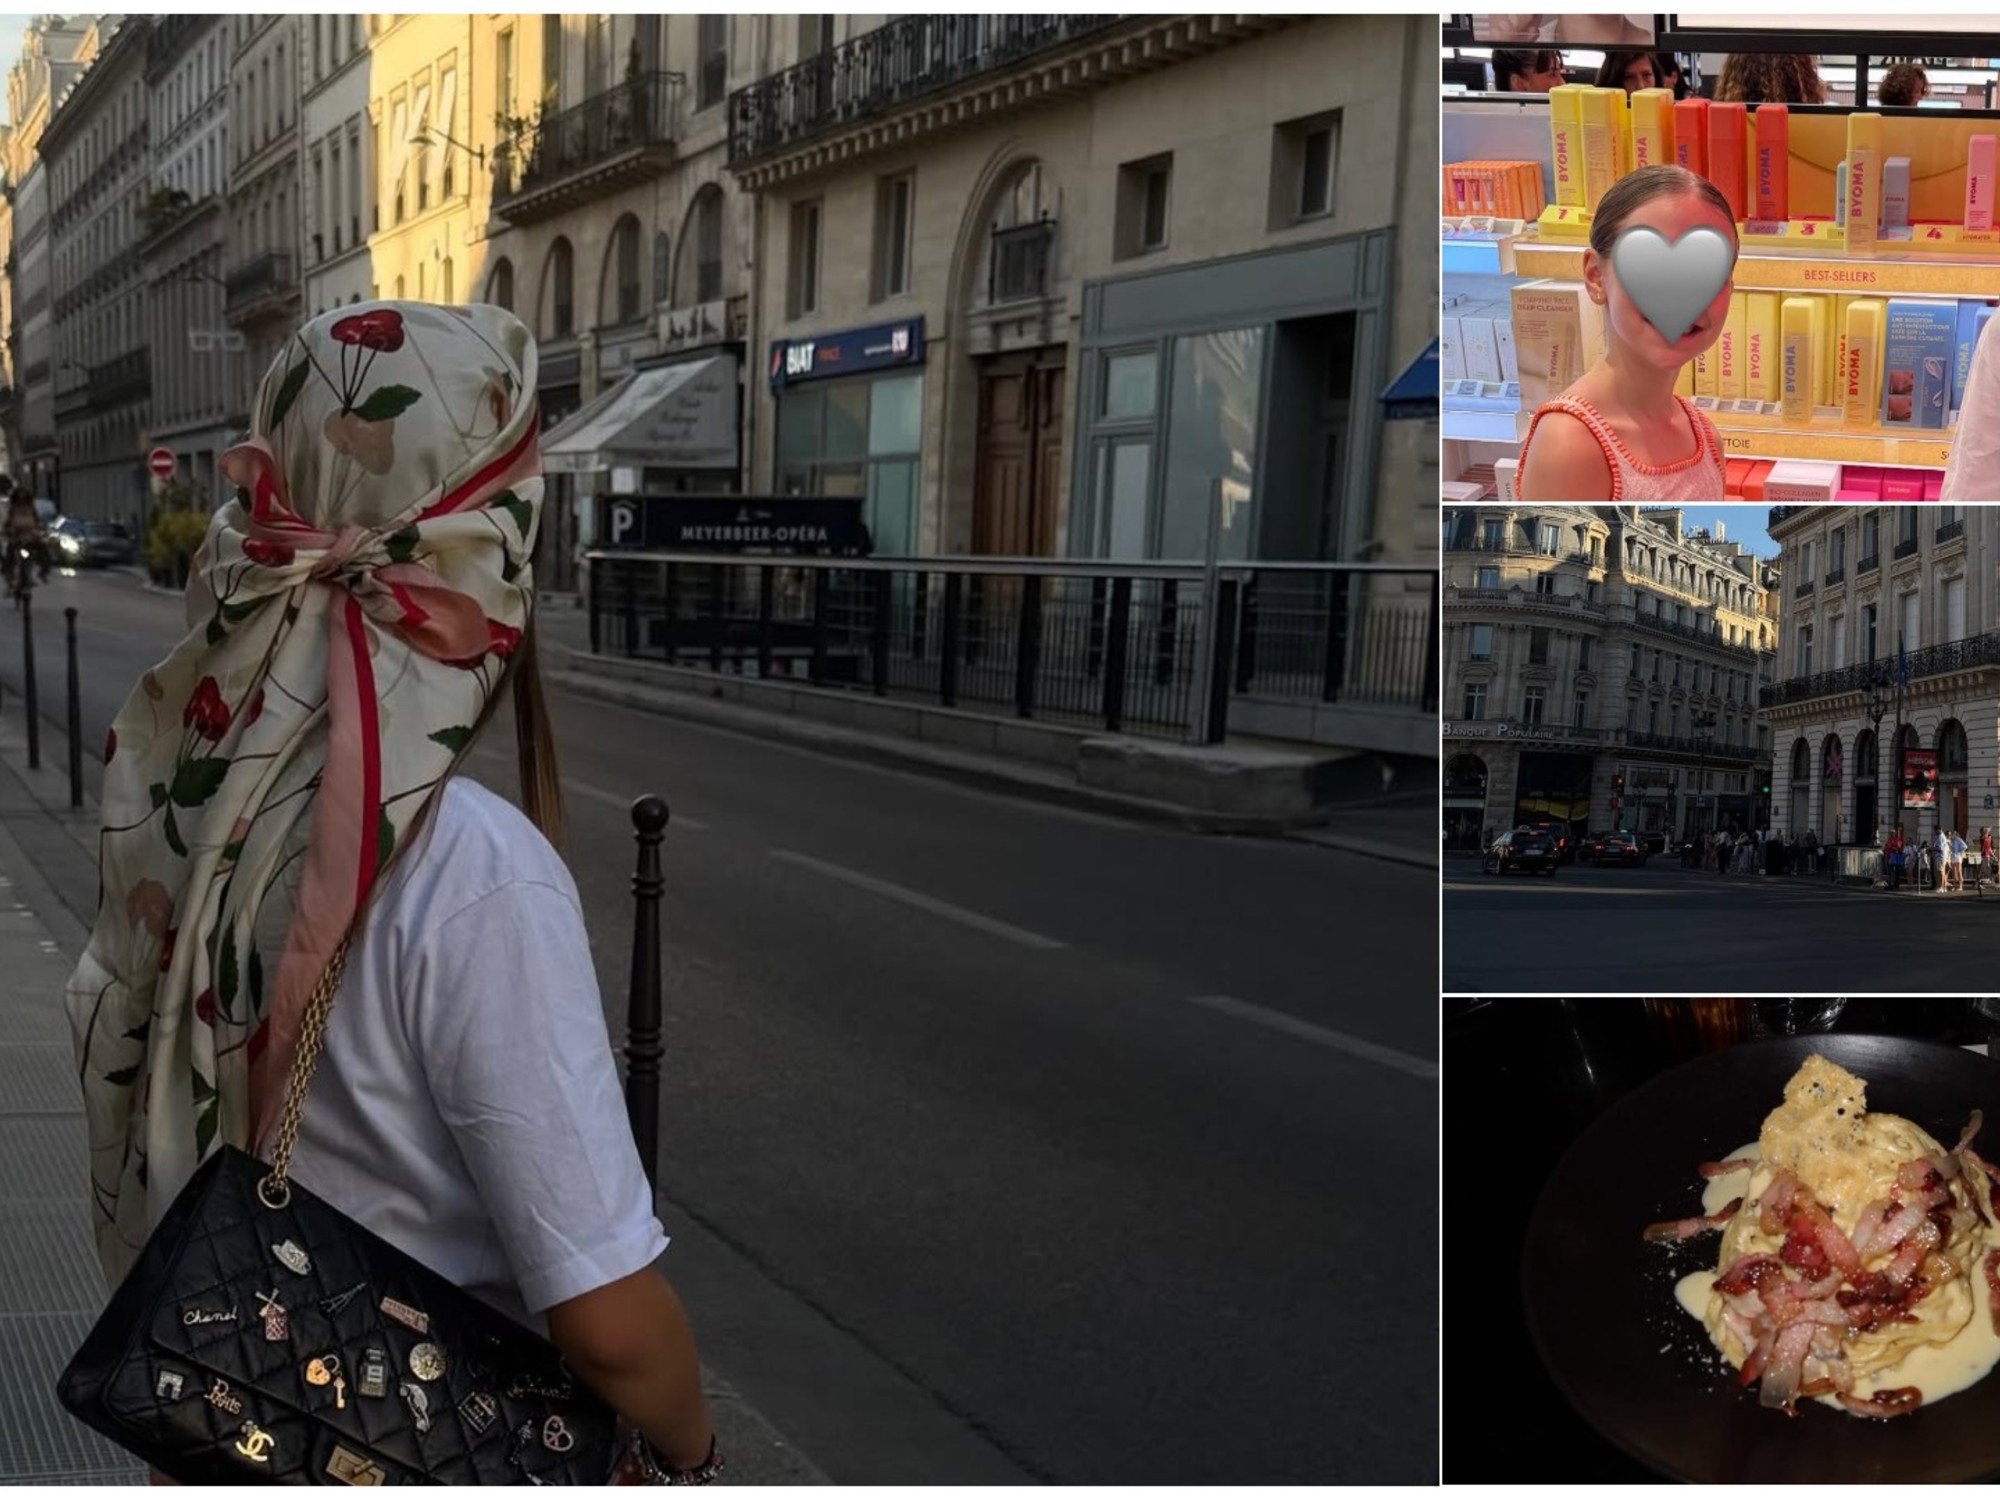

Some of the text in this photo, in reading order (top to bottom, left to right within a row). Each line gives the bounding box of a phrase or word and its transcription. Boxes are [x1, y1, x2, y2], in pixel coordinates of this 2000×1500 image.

[1556, 131, 1568, 183] BYOMA
[1637, 136, 1648, 167] OMA
[1760, 147, 1771, 195] BYOMA
[1851, 161, 1864, 217] BYOMA
[1969, 176, 1978, 204] BYOMA
[1804, 269, 1877, 283] BEST-SELLERS
[1550, 344, 1559, 377] BYOMA
[1698, 352, 1706, 373] BYO
[1722, 331, 1732, 377] BYOMA
[1750, 333, 1761, 379] BYOMA
[1785, 345, 1797, 393] BYOMA
[1848, 347, 1861, 396] BYOMA
[1957, 342, 1970, 389] BYOMA
[611, 508, 634, 543] P
[183, 1304, 238, 1326] Chanel
